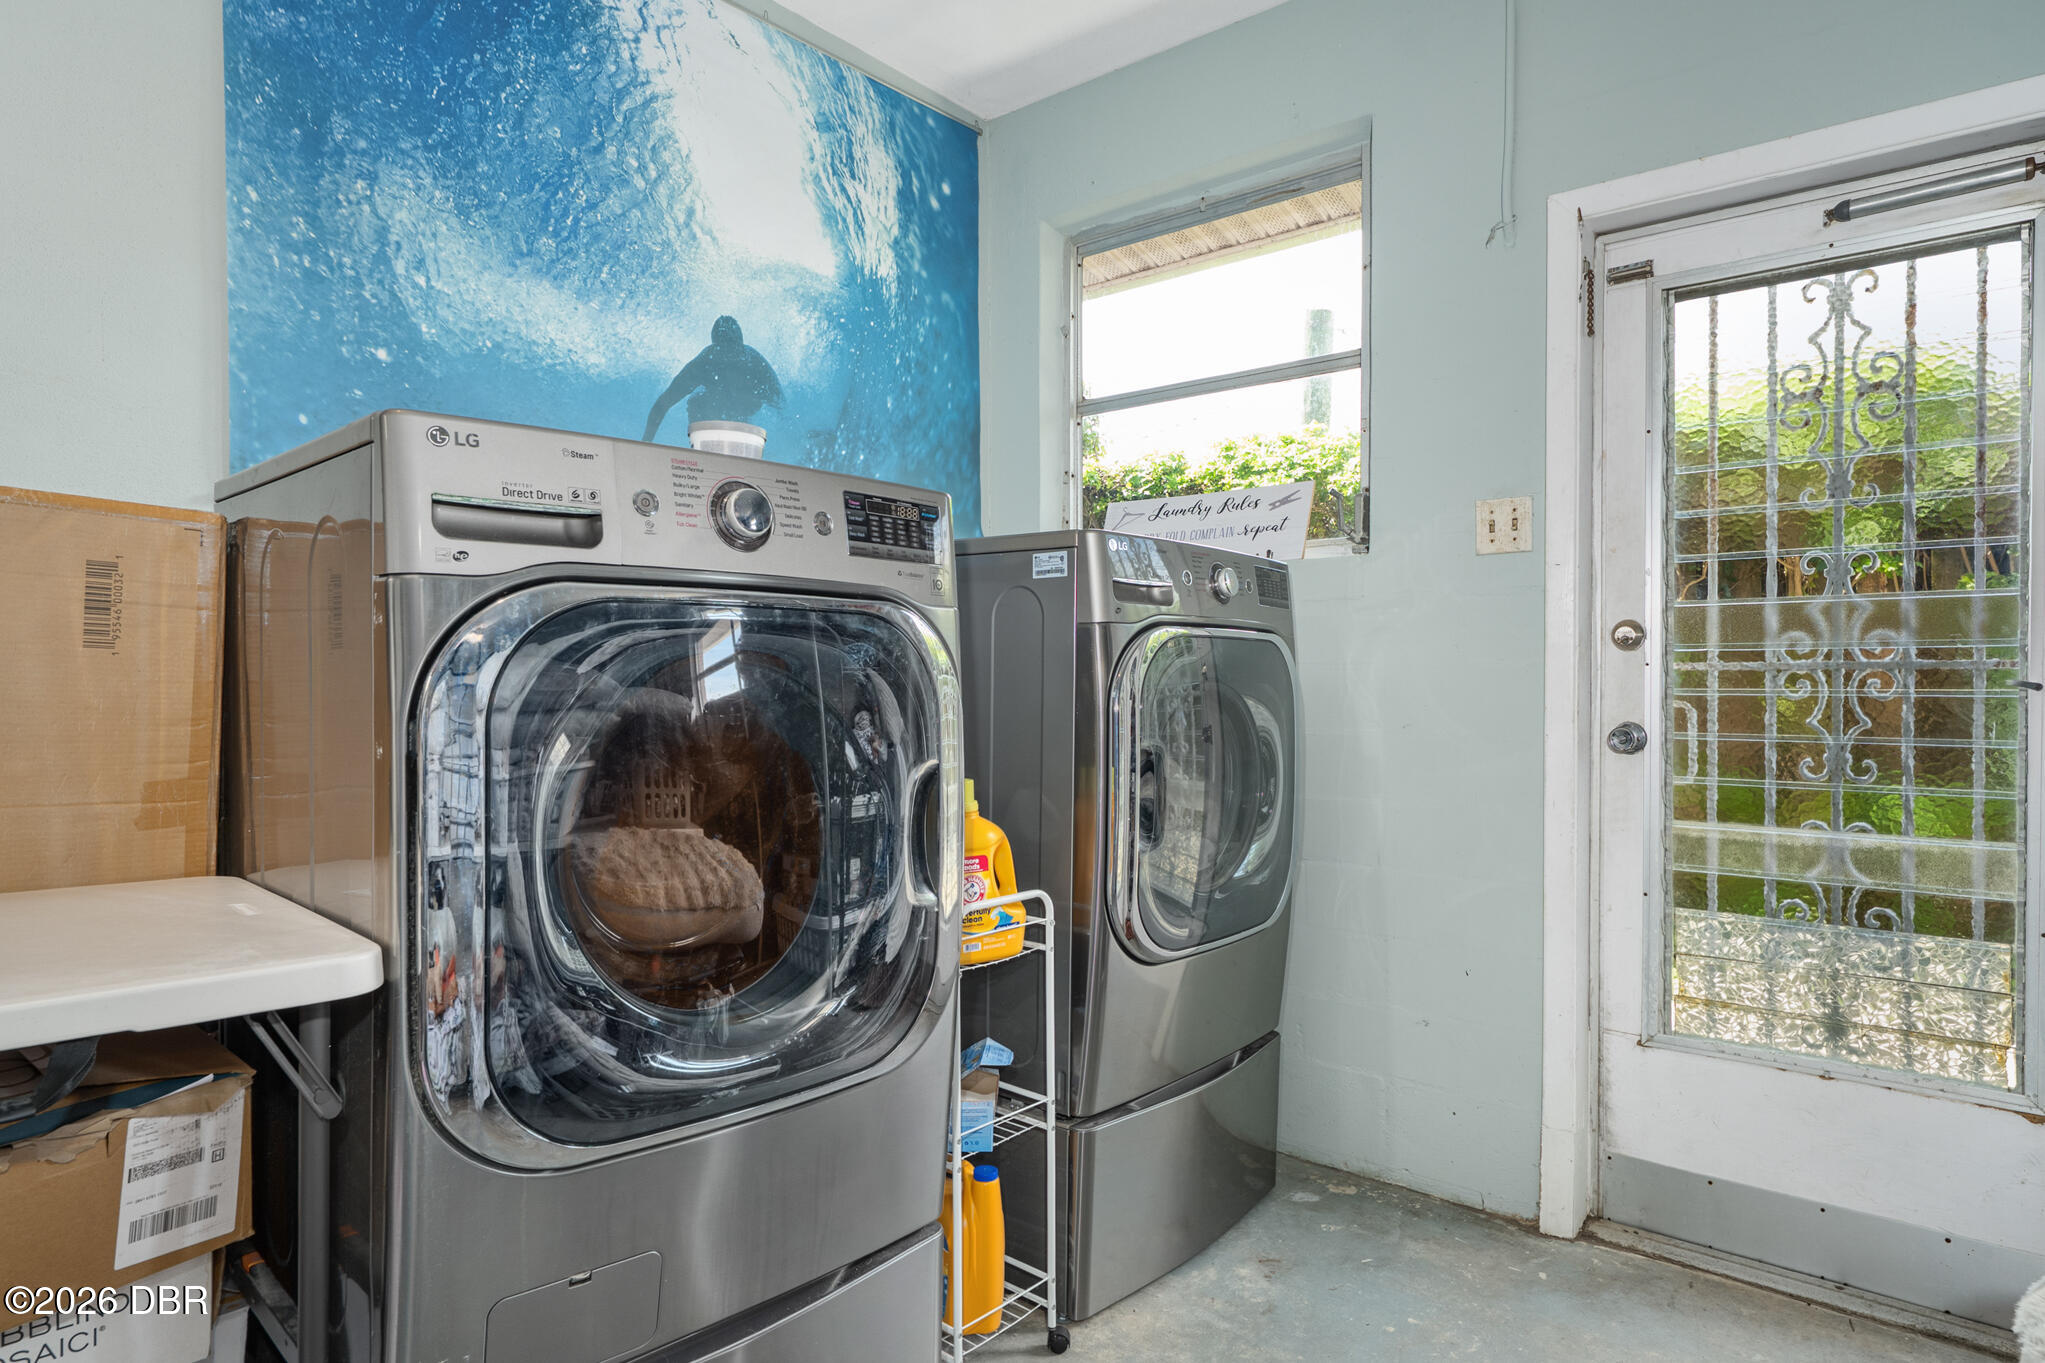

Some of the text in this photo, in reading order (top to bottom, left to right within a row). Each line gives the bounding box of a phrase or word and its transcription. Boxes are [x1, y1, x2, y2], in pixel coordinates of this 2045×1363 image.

[454, 431, 480, 448] LG
[569, 449, 594, 460] Steam
[502, 486, 563, 502] Direct Drive
[1148, 495, 1262, 522] Laundry Rules
[1189, 526, 1236, 541] COMPLAIN
[1237, 515, 1289, 541] repeat
[1118, 541, 1128, 551] LG
[113, 572, 124, 604] 00032
[111, 608, 122, 641] 95546
[962, 916, 983, 924] clean
